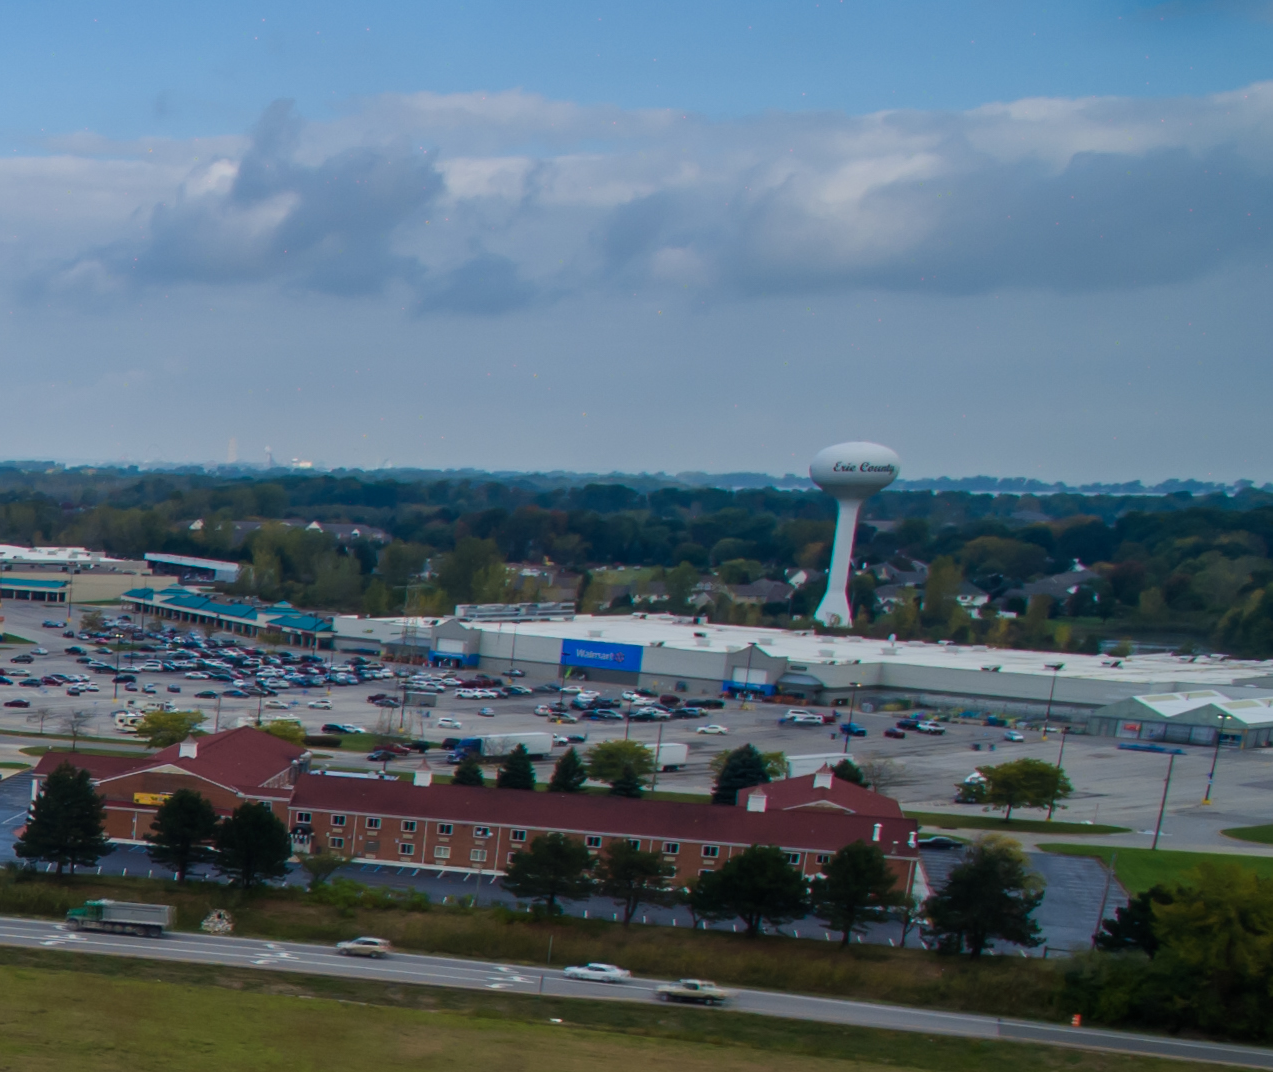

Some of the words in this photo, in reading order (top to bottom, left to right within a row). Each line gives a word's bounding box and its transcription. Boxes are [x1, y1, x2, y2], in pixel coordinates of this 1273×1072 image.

[833, 461, 857, 472] Erie
[859, 461, 895, 475] County
[576, 648, 615, 661] Walmart
